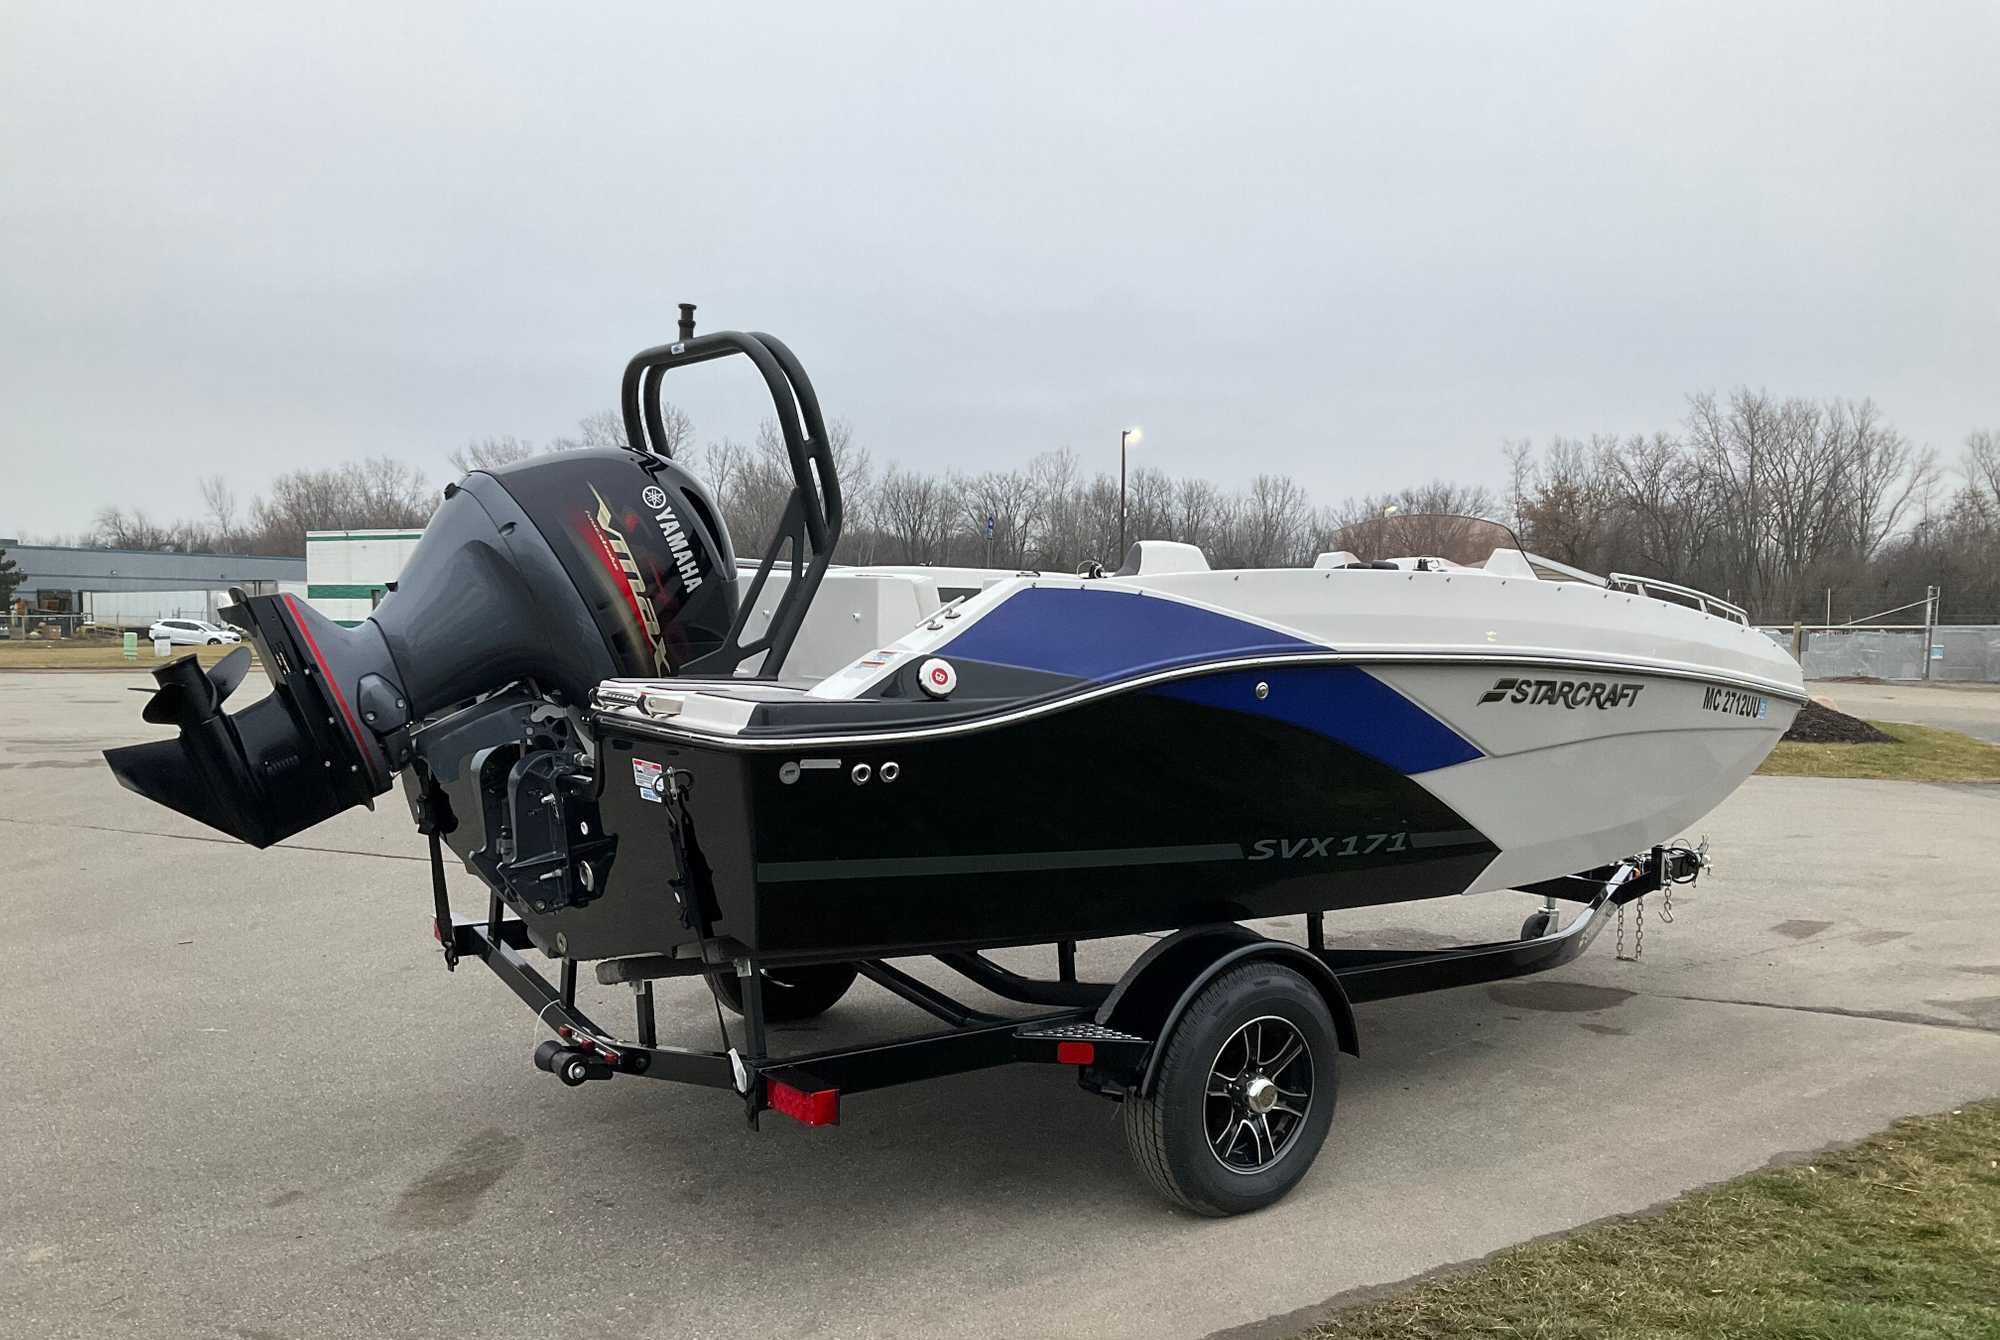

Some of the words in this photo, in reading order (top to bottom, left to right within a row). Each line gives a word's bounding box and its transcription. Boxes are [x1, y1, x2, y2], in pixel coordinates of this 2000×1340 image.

[655, 506, 703, 593] YAMAHA
[1509, 679, 1645, 710] STARCRAFT
[1703, 686, 1721, 711] MC
[1721, 690, 1761, 718] 2712UU
[1248, 837, 1335, 861] SVX
[1337, 832, 1407, 856] 171
